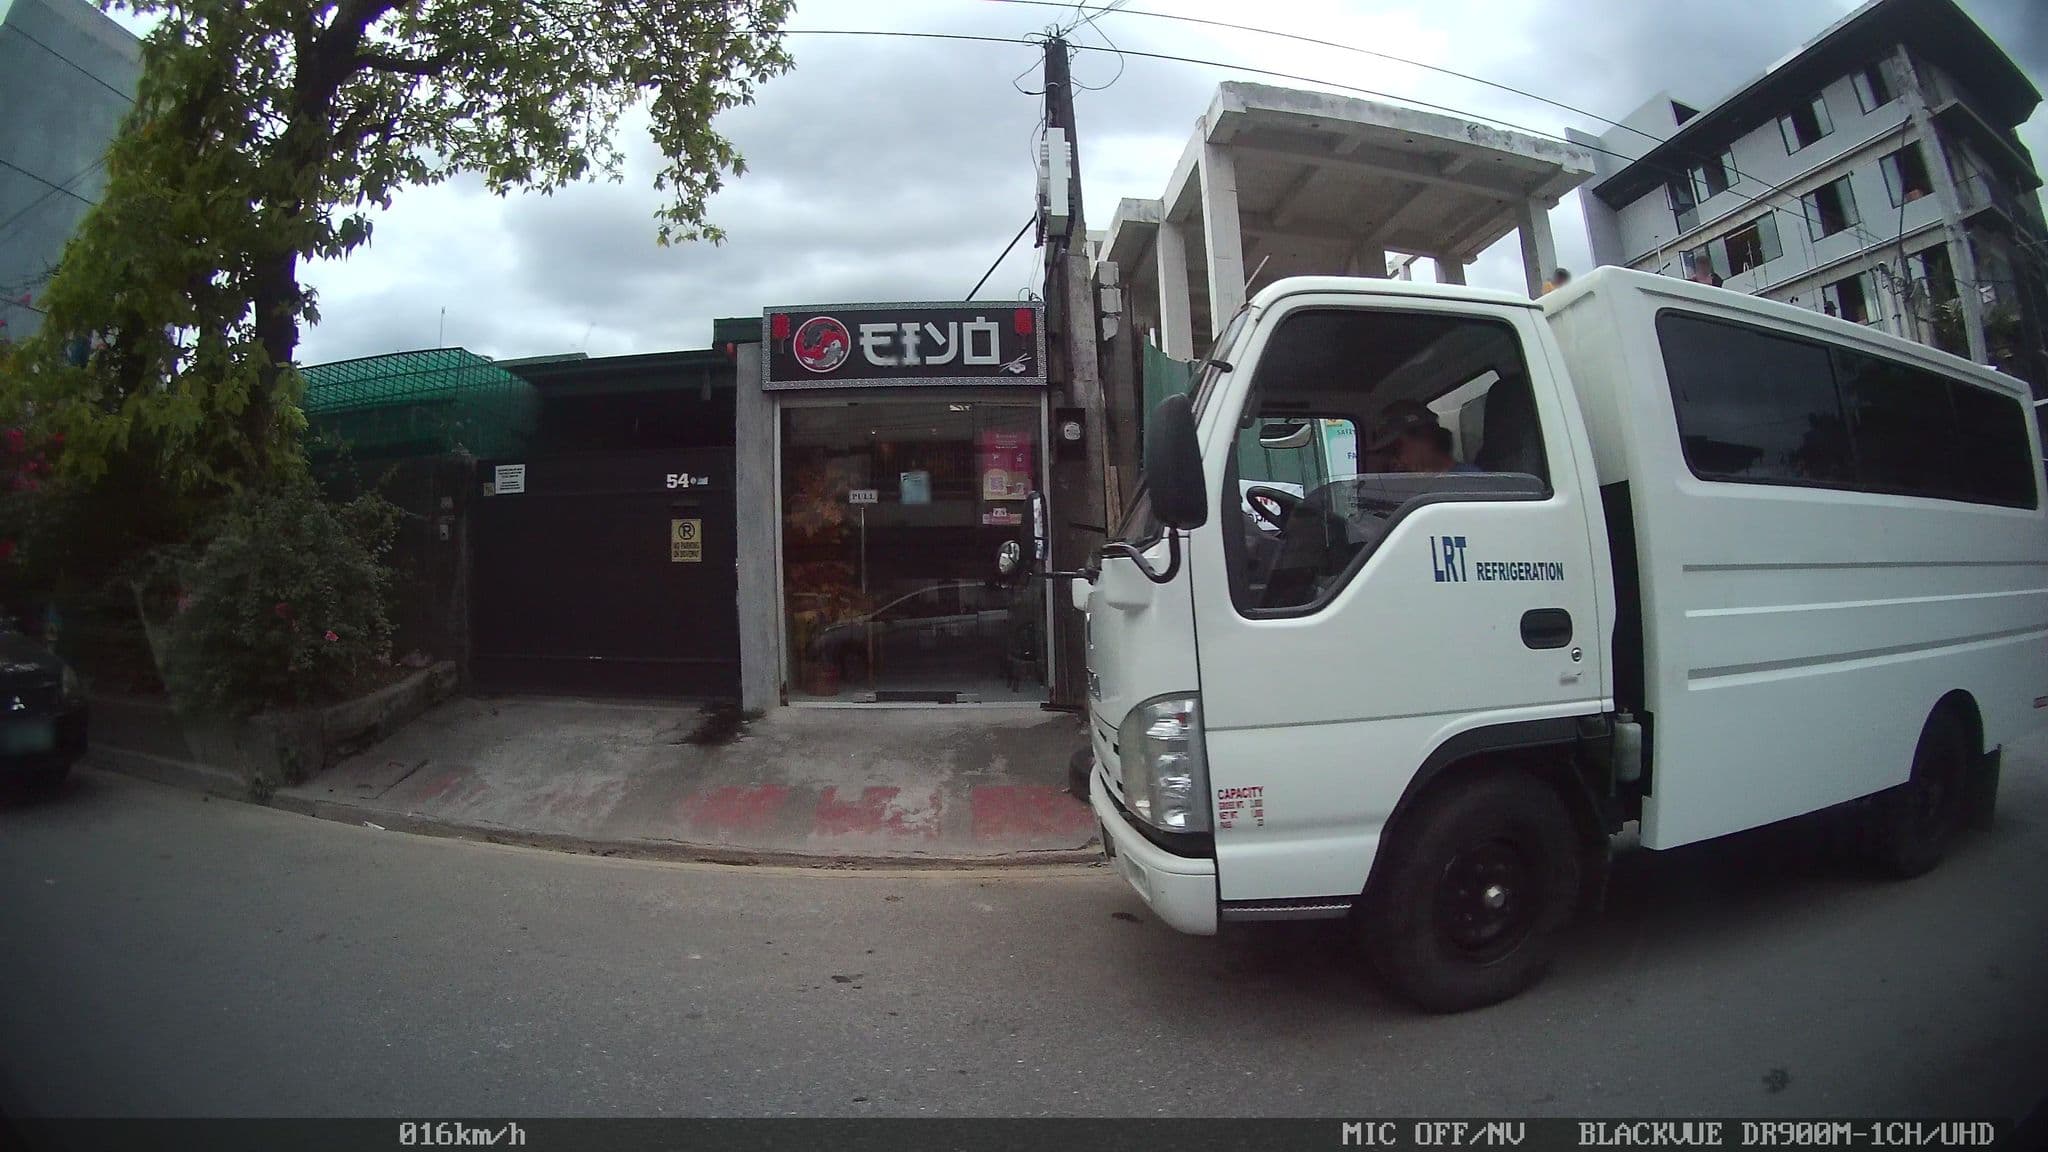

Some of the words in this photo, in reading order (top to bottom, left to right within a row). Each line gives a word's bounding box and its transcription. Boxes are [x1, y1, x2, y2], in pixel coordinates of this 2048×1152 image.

[859, 316, 1000, 366] EIYO
[1430, 536, 1467, 582] LRT
[1476, 562, 1564, 581] REFRIGERATION
[1218, 786, 1264, 800] CAPACITY
